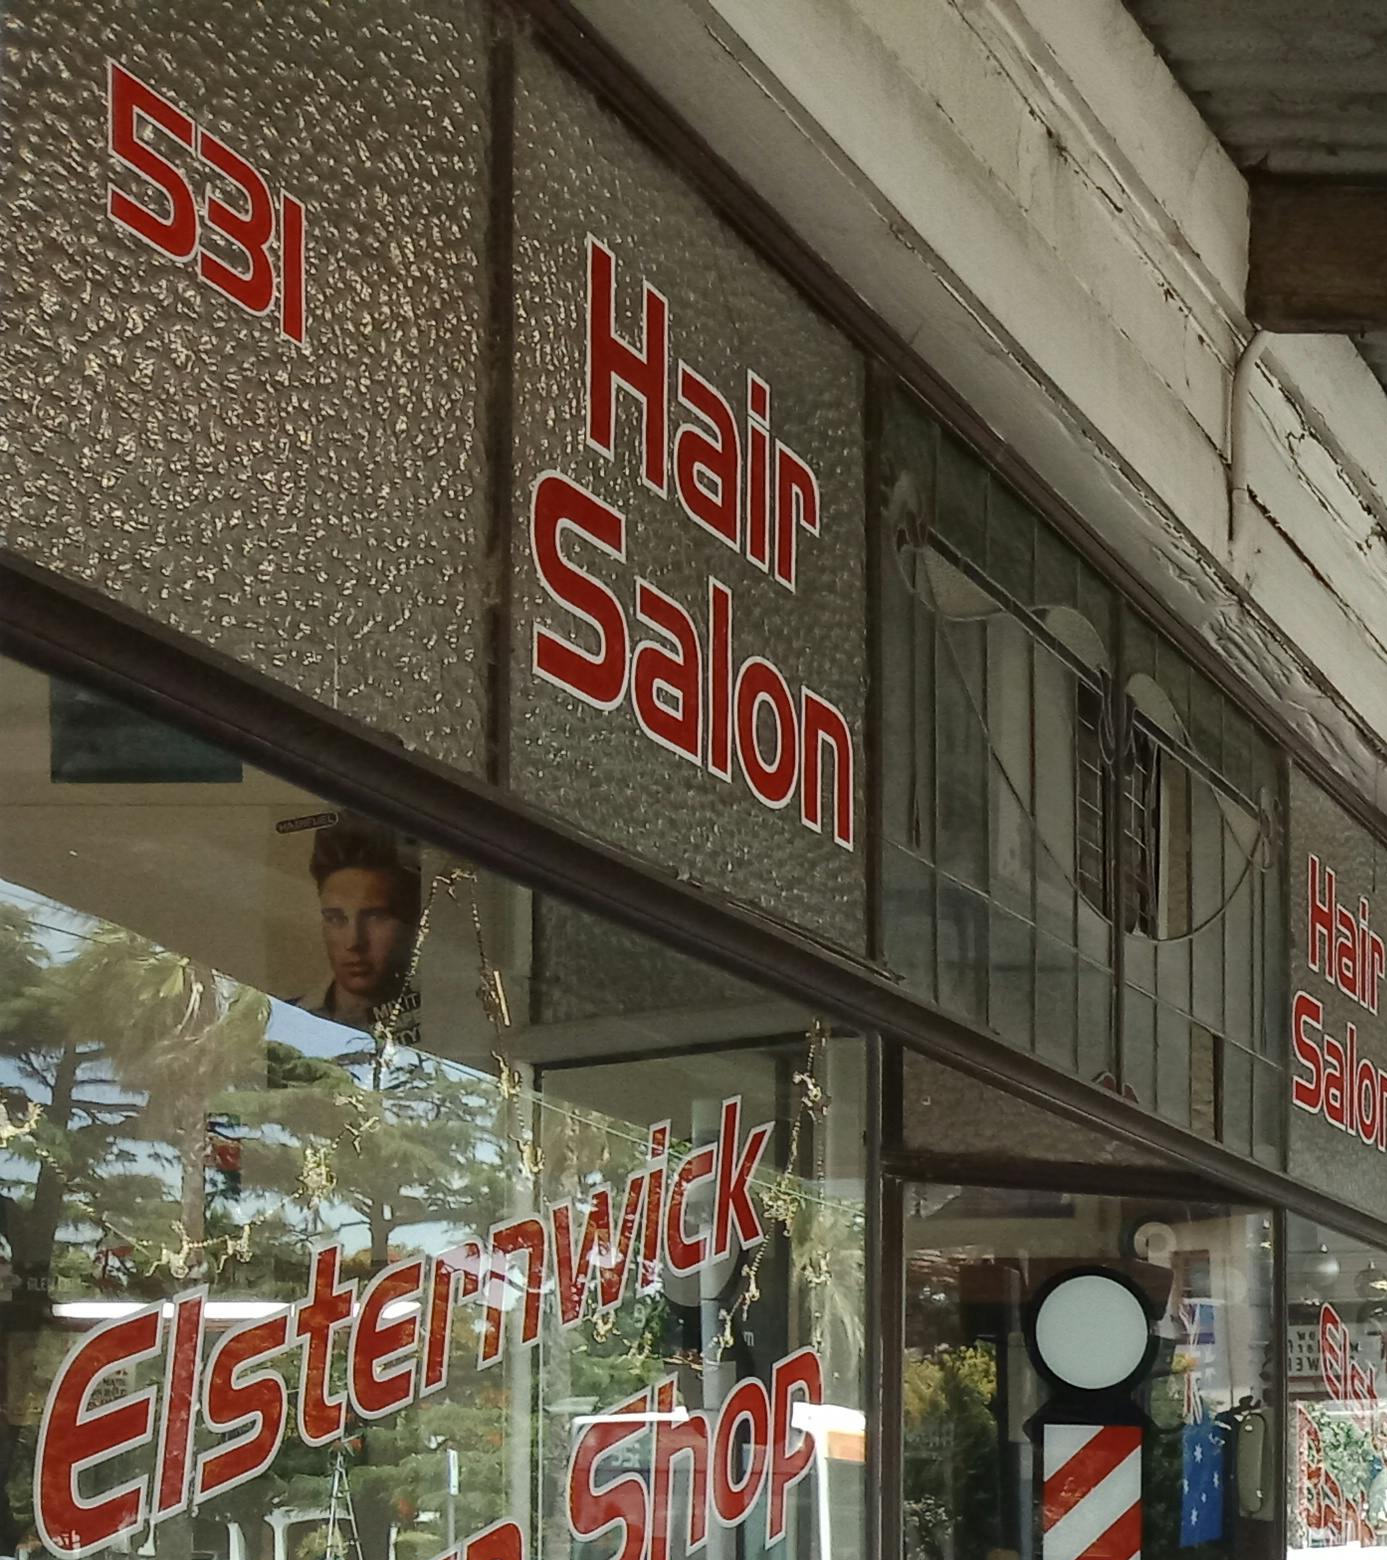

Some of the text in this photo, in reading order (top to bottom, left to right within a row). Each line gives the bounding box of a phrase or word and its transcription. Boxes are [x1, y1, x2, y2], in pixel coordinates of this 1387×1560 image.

[107, 60, 306, 344] 531
[586, 233, 821, 592] Hair
[531, 470, 854, 850] Salon
[1308, 853, 1386, 1015] Hair
[34, 1095, 775, 1560] Elsternwick
